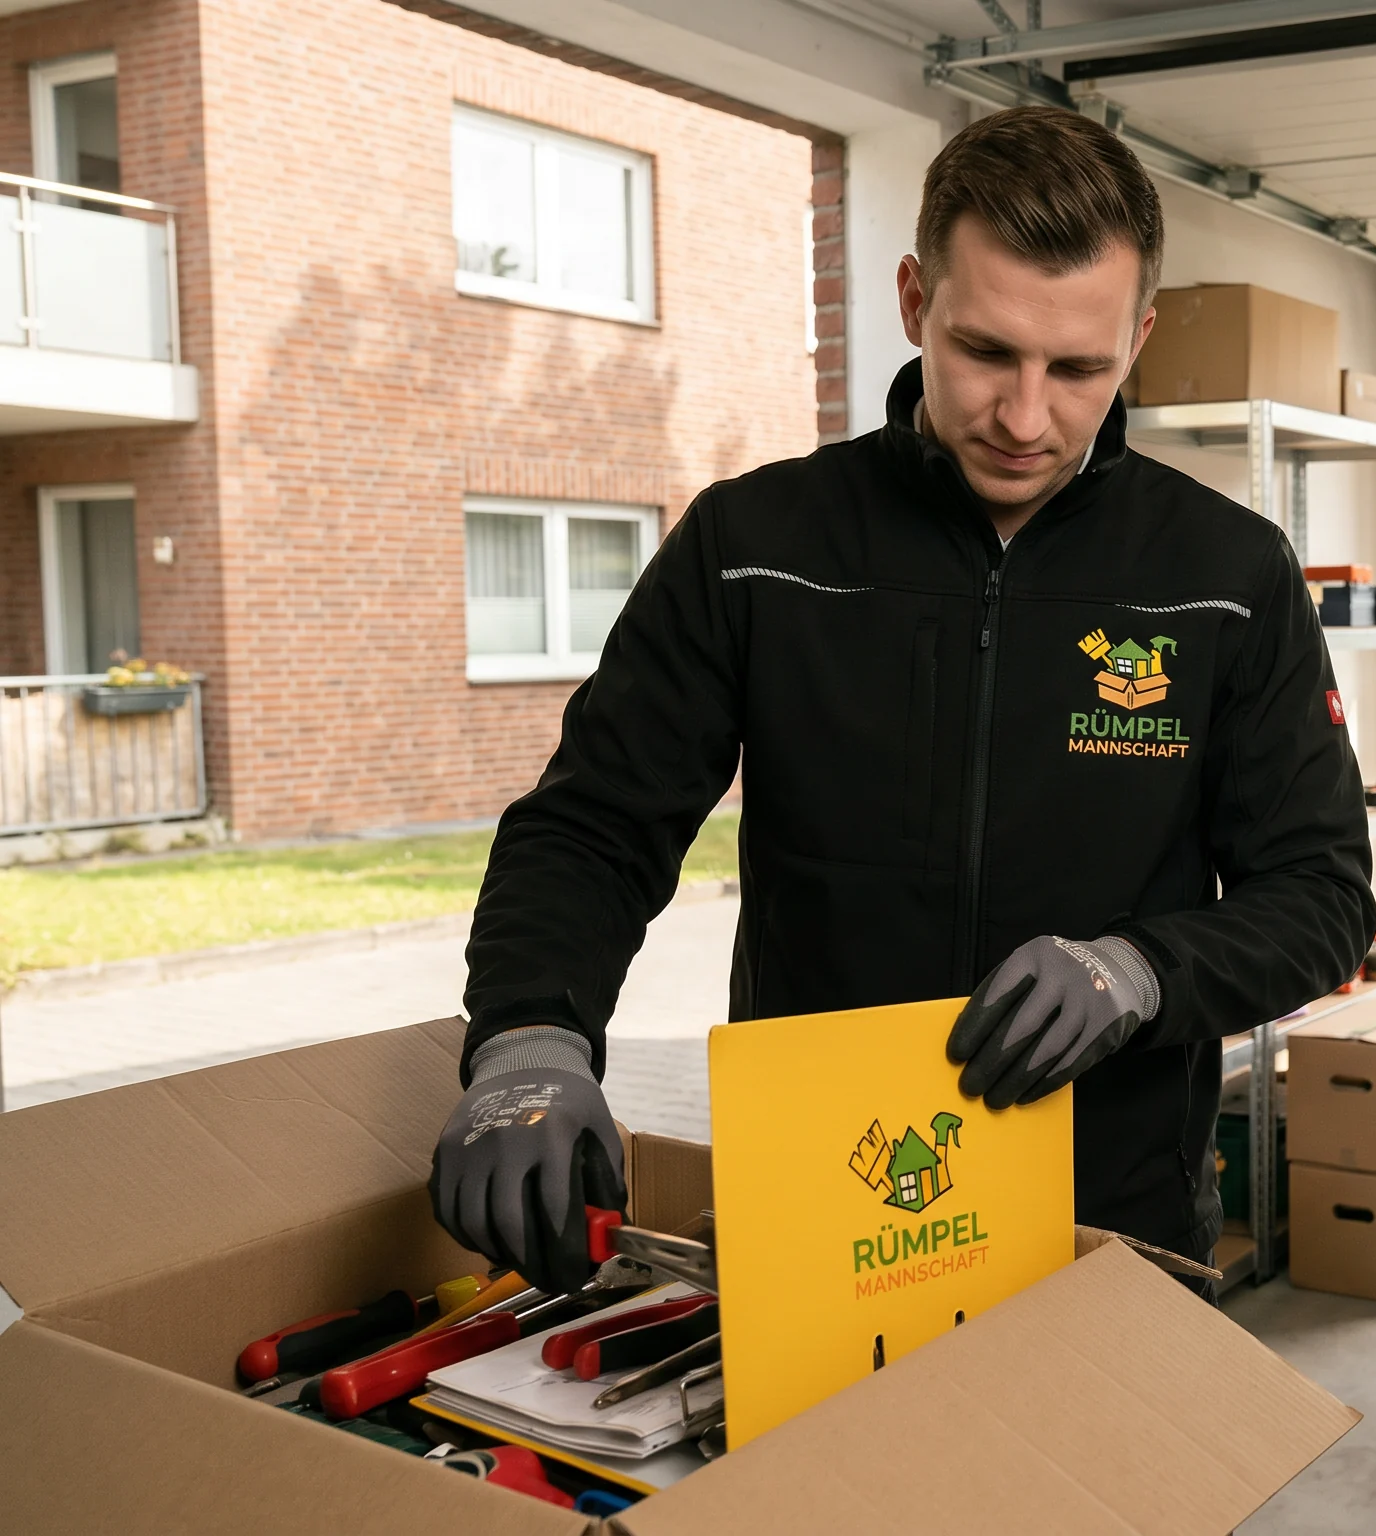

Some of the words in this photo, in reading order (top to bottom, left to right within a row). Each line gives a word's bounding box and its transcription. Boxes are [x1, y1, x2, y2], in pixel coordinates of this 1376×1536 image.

[1070, 708, 1190, 741] RÜMPEL
[1068, 738, 1189, 758] MANNSCHAFT
[853, 1211, 988, 1273] RÜMPEL
[855, 1245, 990, 1300] MANNSCHAFT
